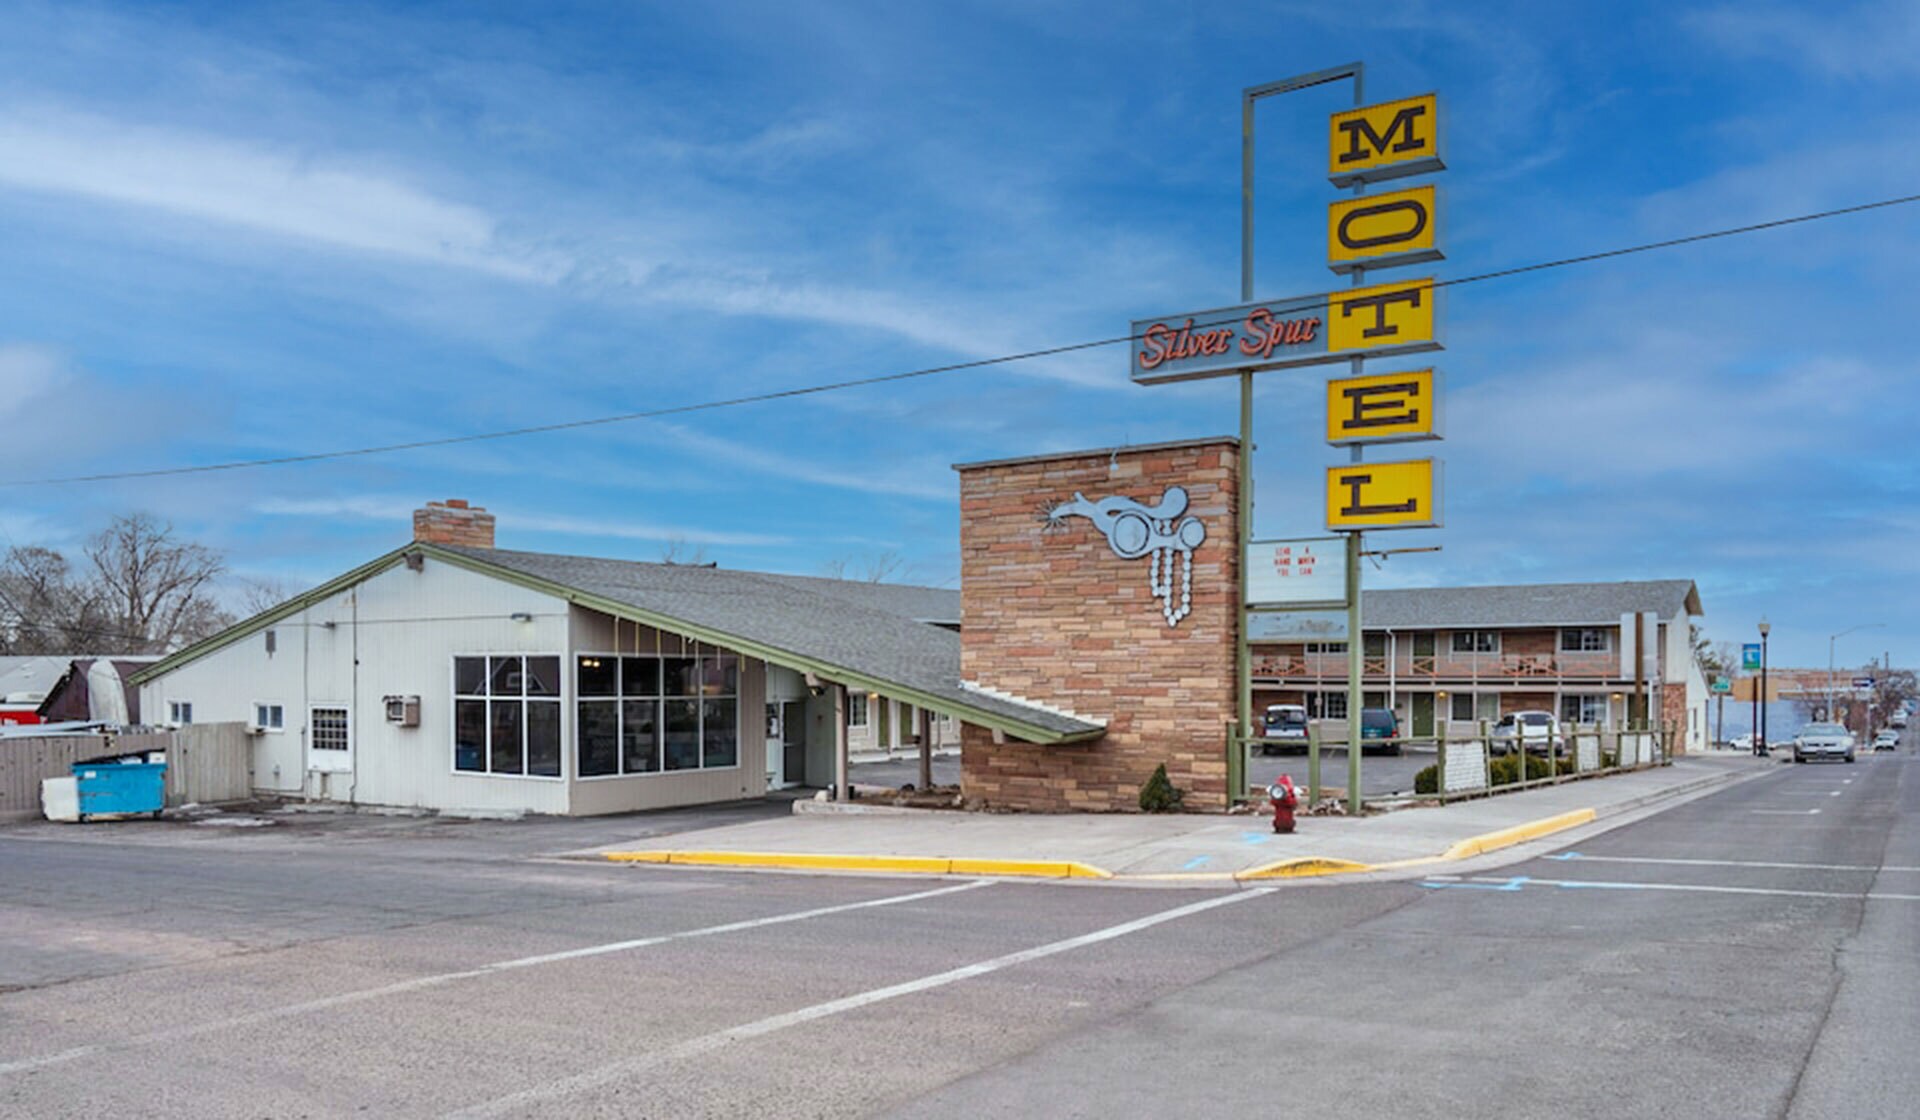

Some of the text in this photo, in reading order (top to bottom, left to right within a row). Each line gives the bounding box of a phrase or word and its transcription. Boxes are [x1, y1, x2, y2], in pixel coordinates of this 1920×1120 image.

[1140, 308, 1321, 369] Silver Spur
[1338, 105, 1426, 518] MOTEL
